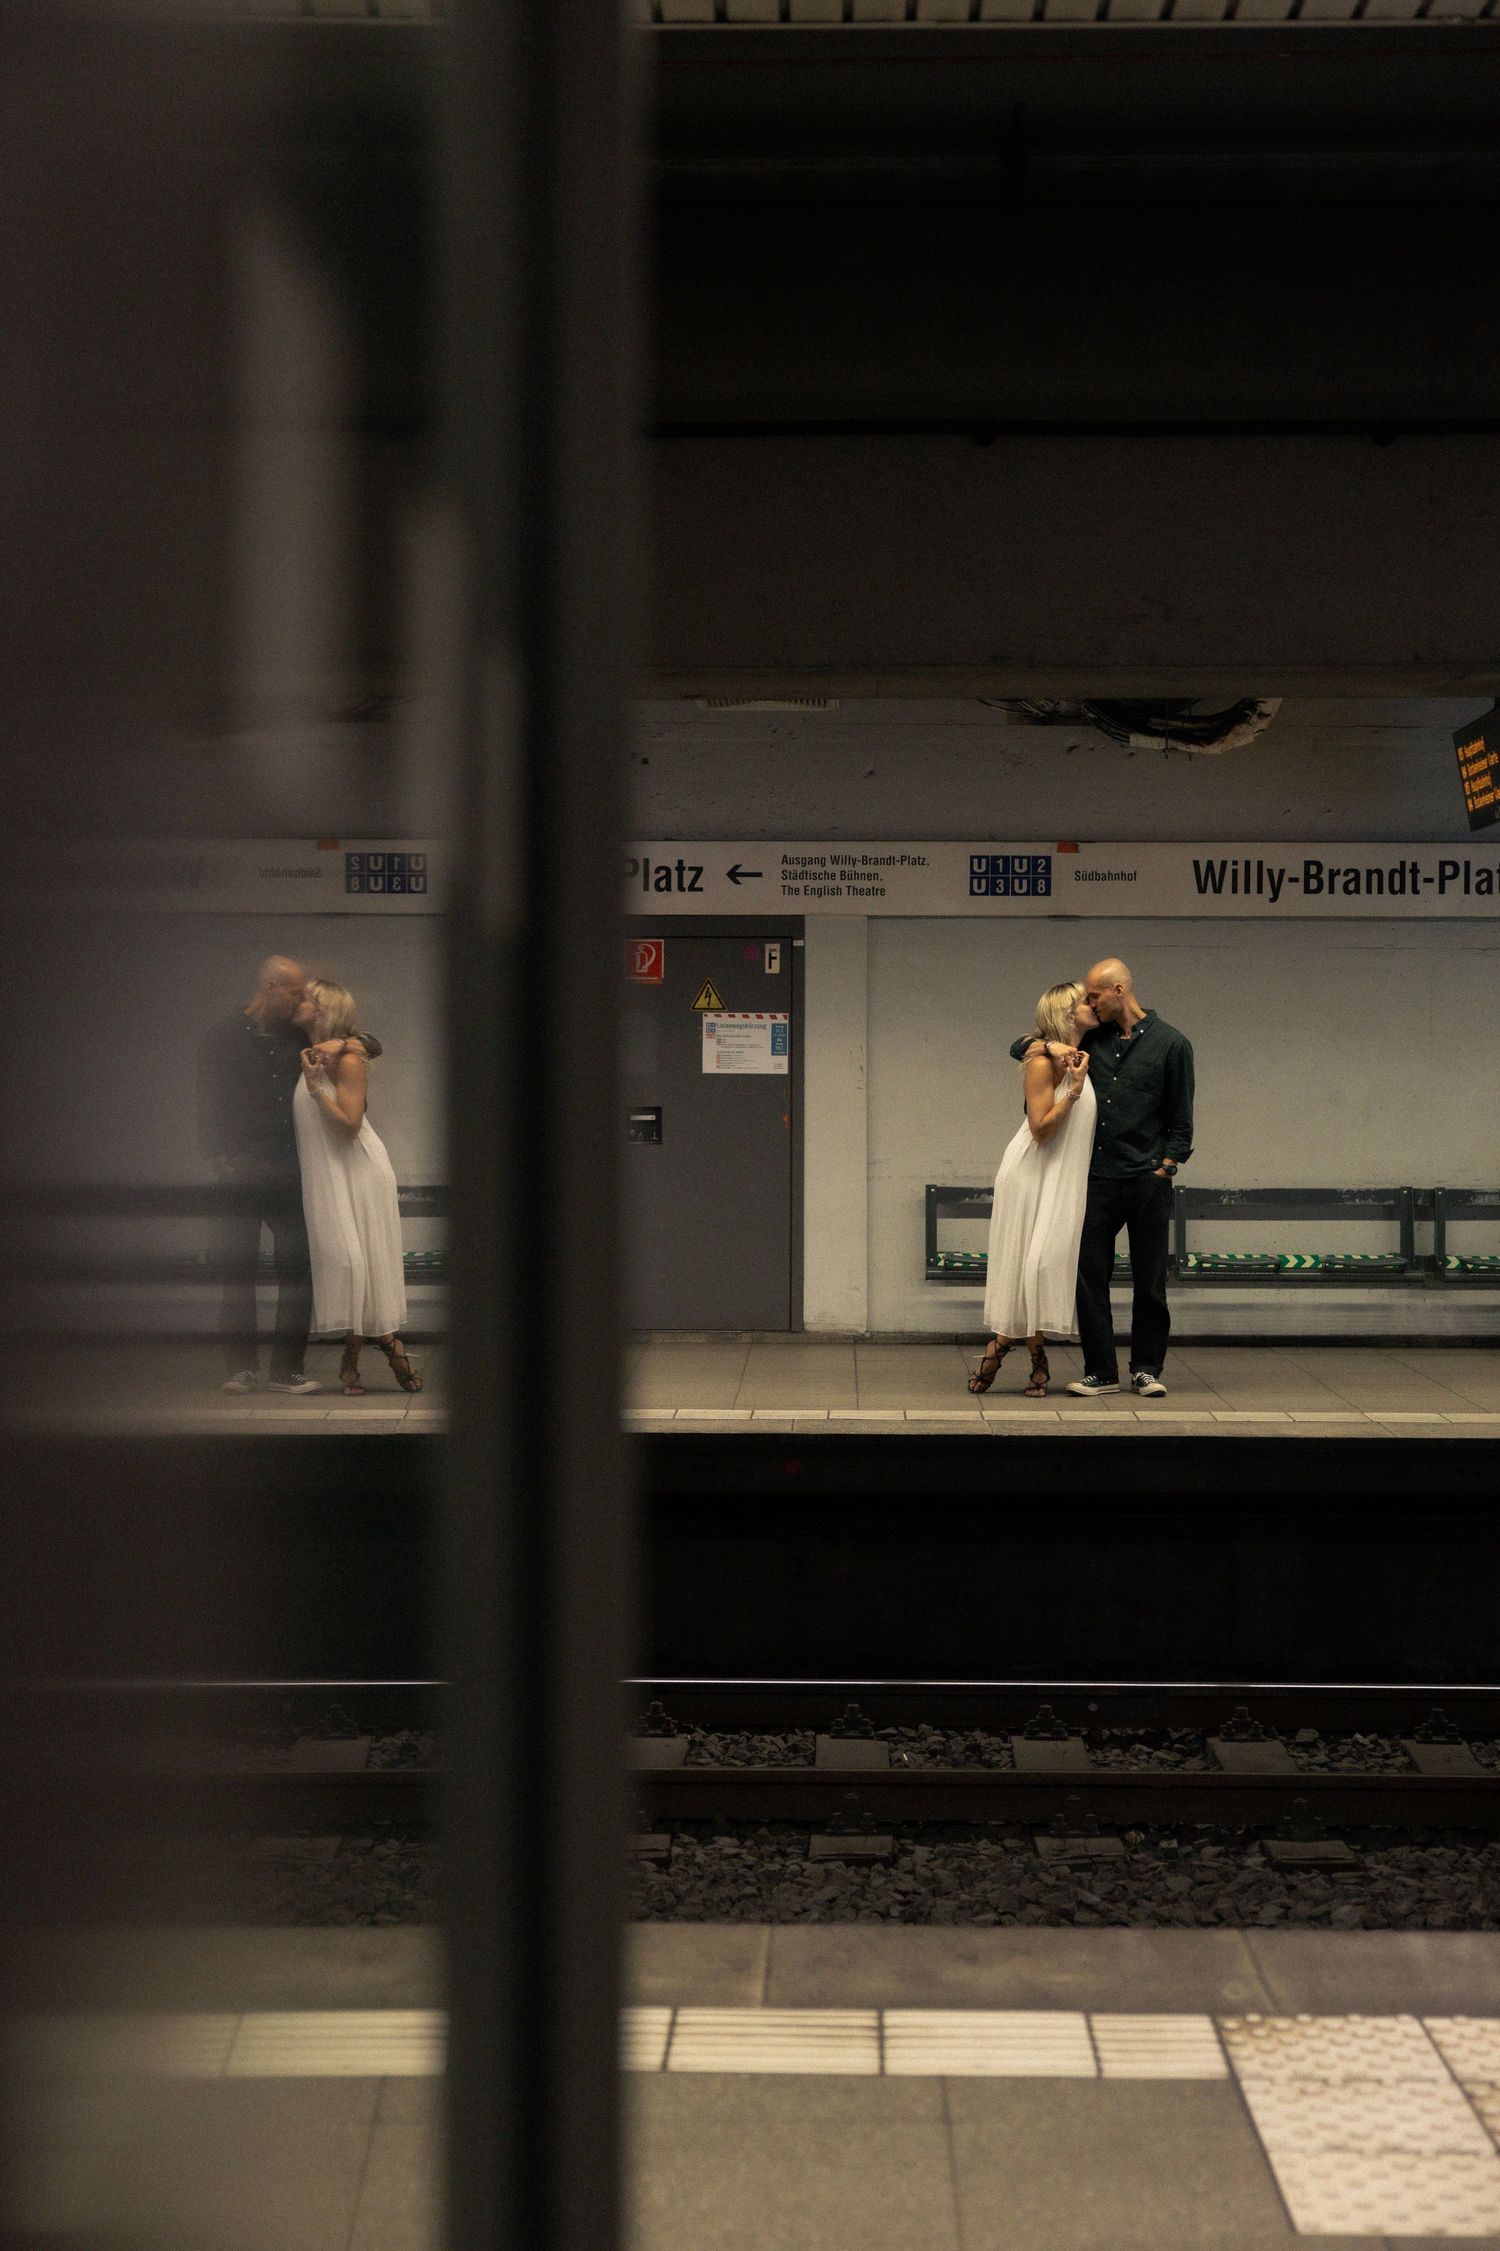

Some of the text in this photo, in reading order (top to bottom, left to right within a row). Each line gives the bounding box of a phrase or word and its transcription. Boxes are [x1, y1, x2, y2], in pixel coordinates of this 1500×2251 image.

[781, 855, 930, 867] Ausgang Willy-Brandt-Platz,
[781, 869, 883, 882] Städtische Bühnen,
[1074, 870, 1137, 882] Südbahnhof
[1192, 859, 1500, 903] Willy-Brandt-Pla
[781, 885, 886, 898] The English Theatre
[768, 948, 777, 969] F
